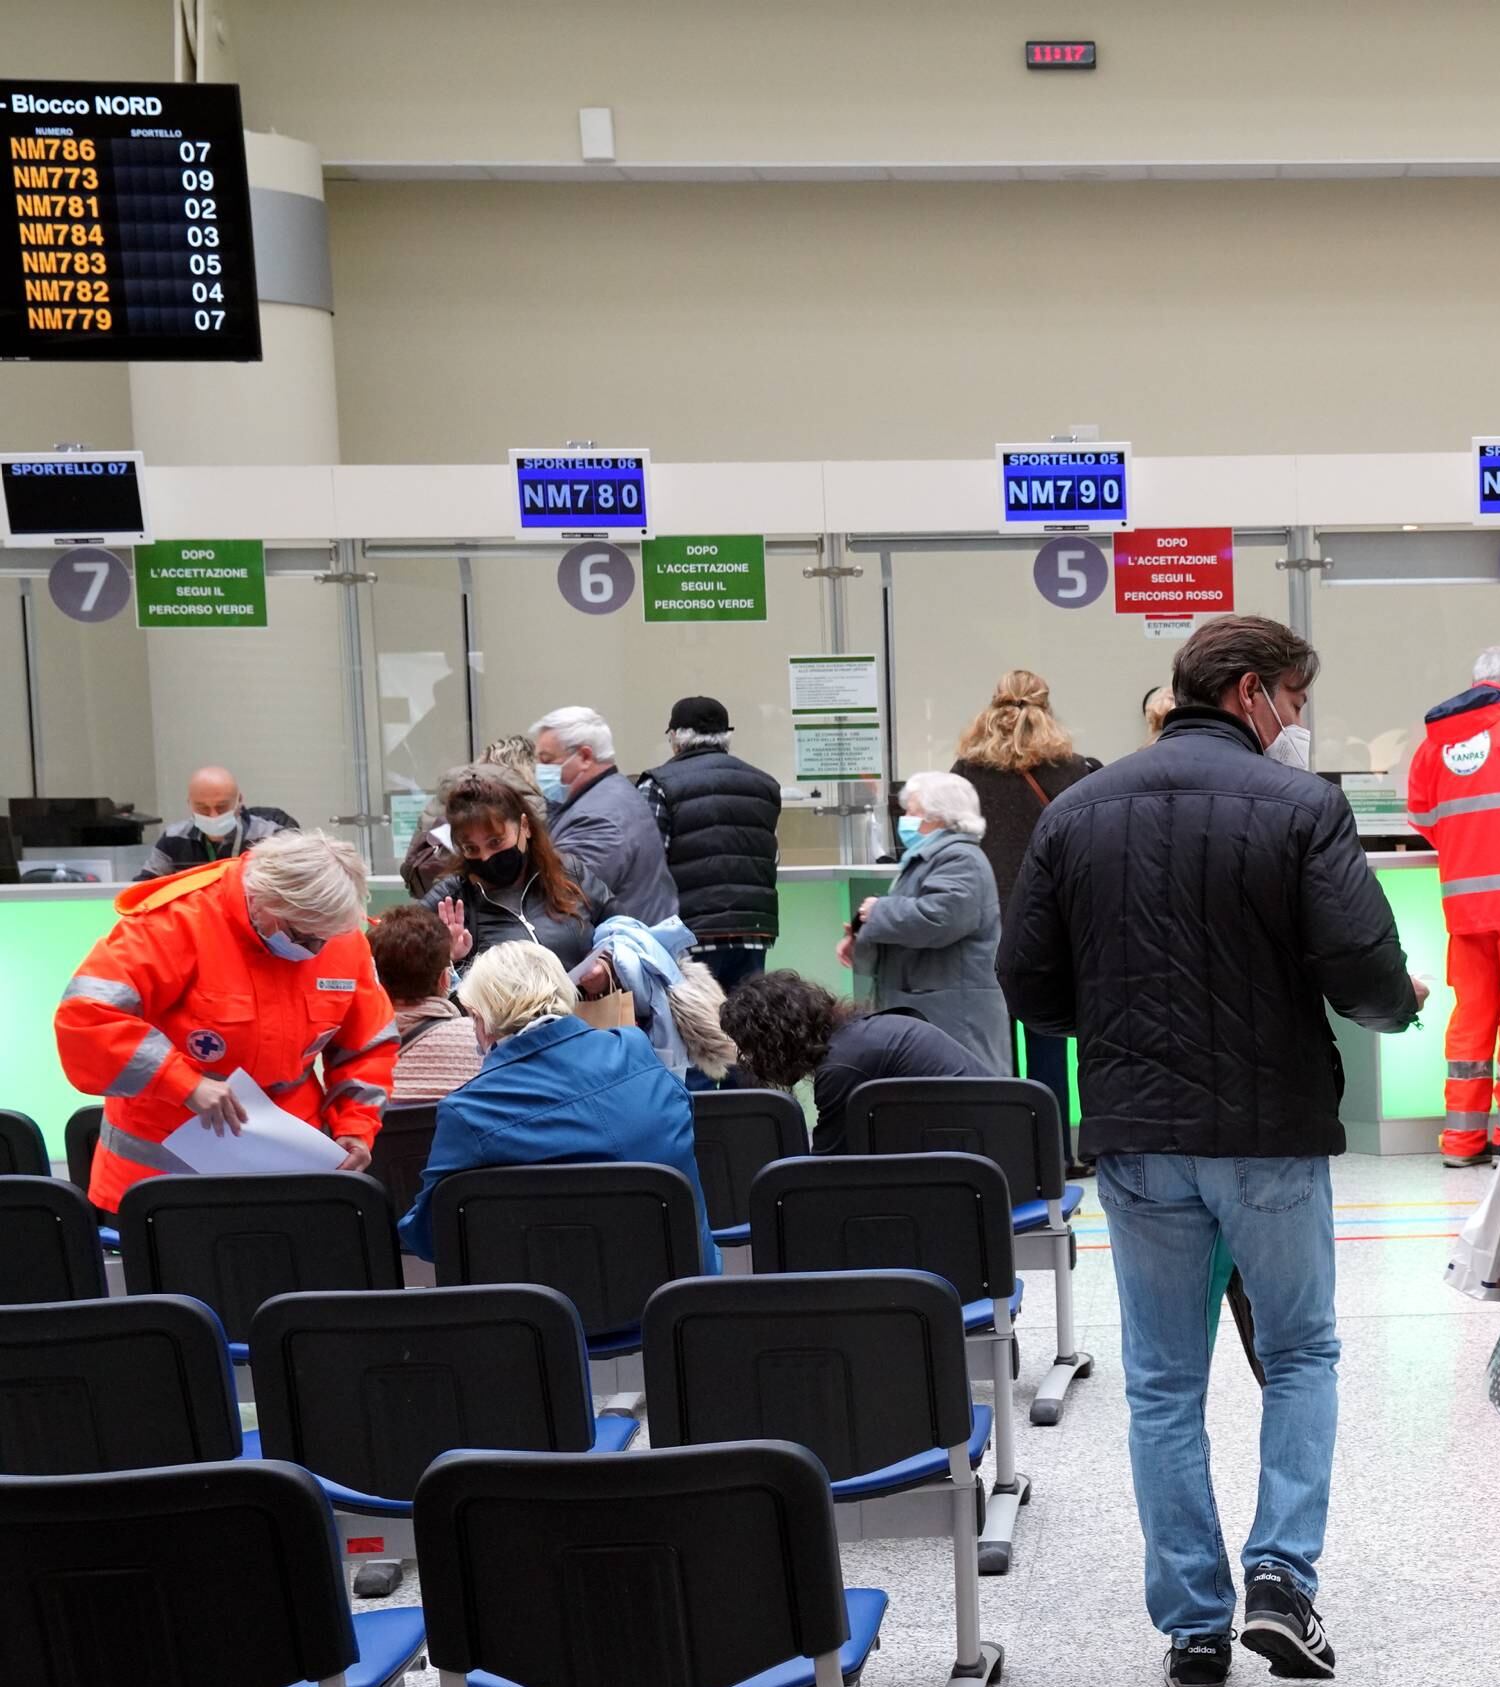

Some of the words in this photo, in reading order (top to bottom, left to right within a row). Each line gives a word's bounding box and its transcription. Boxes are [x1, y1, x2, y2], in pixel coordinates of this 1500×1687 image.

[12, 94, 90, 114] Blocco
[95, 96, 162, 116] NORD
[35, 127, 74, 136] NUMERO
[131, 129, 182, 138] SPORTELLO
[11, 138, 96, 161] NM786
[179, 142, 212, 163] 07
[14, 166, 99, 190] NM773
[182, 170, 215, 192] 09
[16, 195, 99, 218] NM781
[184, 199, 217, 220] 02
[19, 224, 104, 246] NM784
[187, 227, 220, 248] 03
[22, 252, 107, 274] NM783
[190, 255, 222, 276] 05
[25, 280, 110, 303] NM782
[192, 283, 224, 303] 04
[28, 308, 112, 330] NM779
[194, 311, 226, 331] 07
[524, 459, 613, 470] SPORTELLO
[617, 459, 636, 470] 06
[1010, 454, 1096, 466] SPORTELLO
[1100, 454, 1119, 465] 05
[11, 463, 104, 476] SPORTELLO
[108, 462, 128, 475] 07
[523, 484, 639, 509] NM780
[1008, 480, 1120, 505] NM790
[1157, 538, 1188, 548] DOPO
[181, 550, 215, 561] DOPO
[687, 545, 718, 556] DOPO
[1128, 555, 1218, 566] L'ACCETTAZIONE
[150, 568, 248, 578] L'ACCETTAZIONE
[657, 564, 749, 574] L'ACCETTAZIONE
[1056, 550, 1088, 599] 5
[579, 553, 614, 603] 6
[1151, 573, 1184, 583] SEGUI
[1186, 573, 1195, 583] IL
[73, 562, 110, 612] 7
[176, 587, 212, 597] SEGUI
[214, 587, 225, 597] IL
[681, 582, 715, 591] SEGUI
[716, 582, 727, 591] IL
[1124, 592, 1184, 601] PERCORSO
[1185, 591, 1223, 601] ROSSO
[149, 605, 213, 615] PERCORSO
[215, 605, 255, 615] VERDE
[655, 600, 715, 610] PERCORSO
[717, 599, 755, 609] VERDE
[1254, 1573, 1282, 1583] adidas
[1188, 1646, 1216, 1654] adidas
